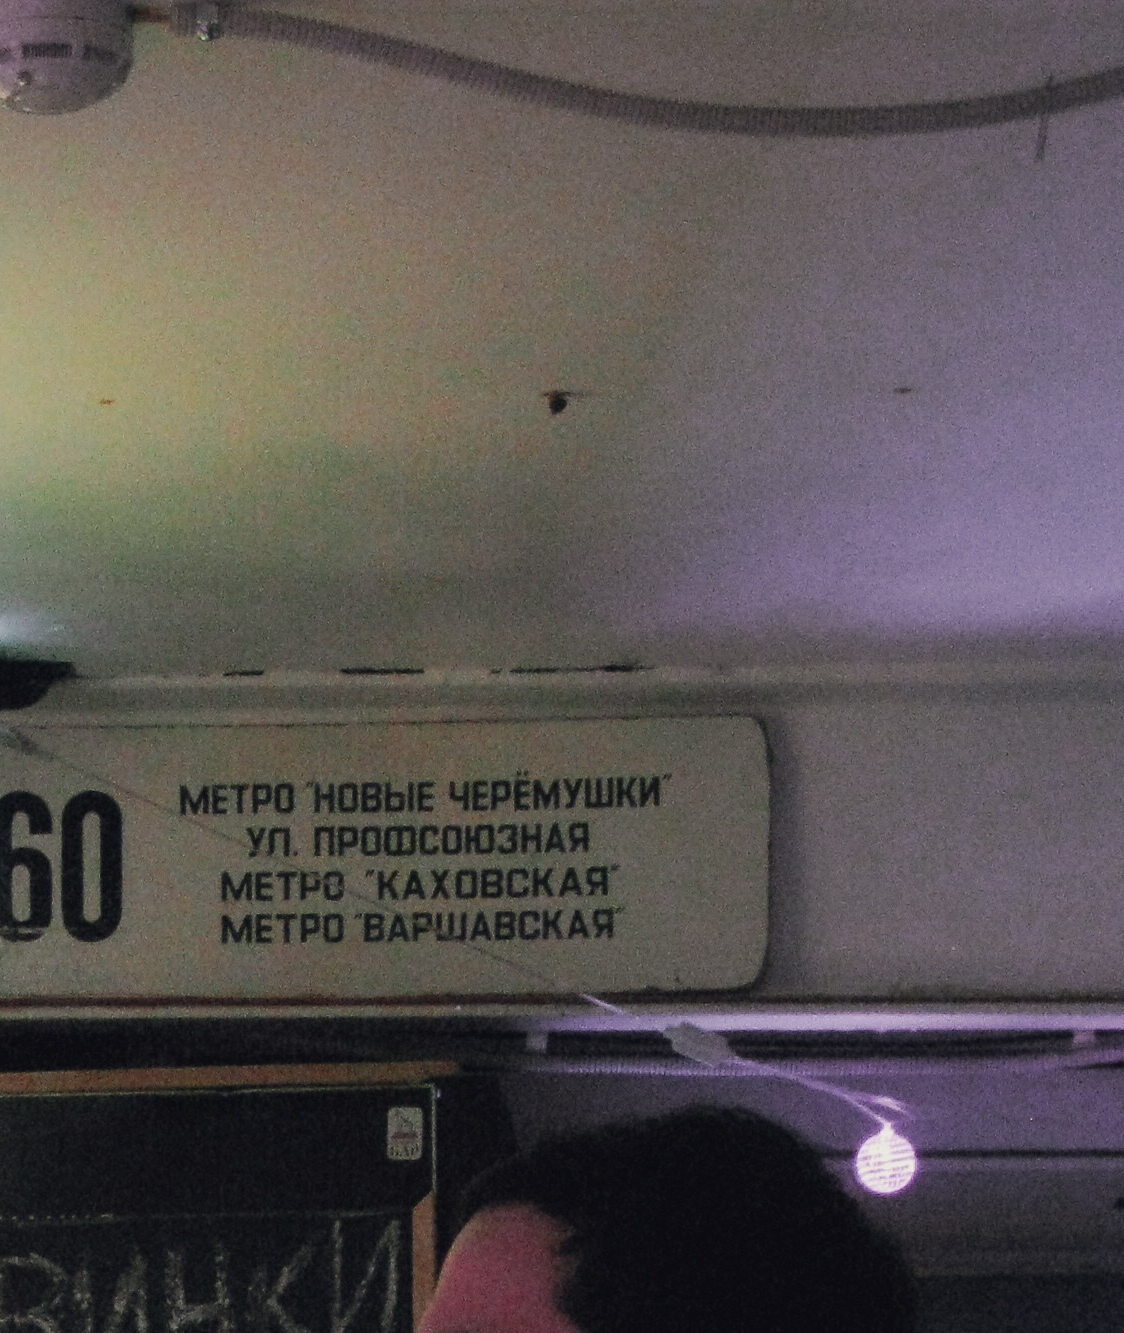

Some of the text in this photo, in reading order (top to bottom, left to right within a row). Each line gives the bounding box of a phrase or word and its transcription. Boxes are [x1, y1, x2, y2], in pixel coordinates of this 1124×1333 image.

[179, 783, 295, 815] МЕТРО
[246, 822, 590, 857] УЛ. ПРОФСОЮЗНАЯ
[221, 870, 345, 901] МЕТРО
[221, 913, 344, 944] МЕТРО
